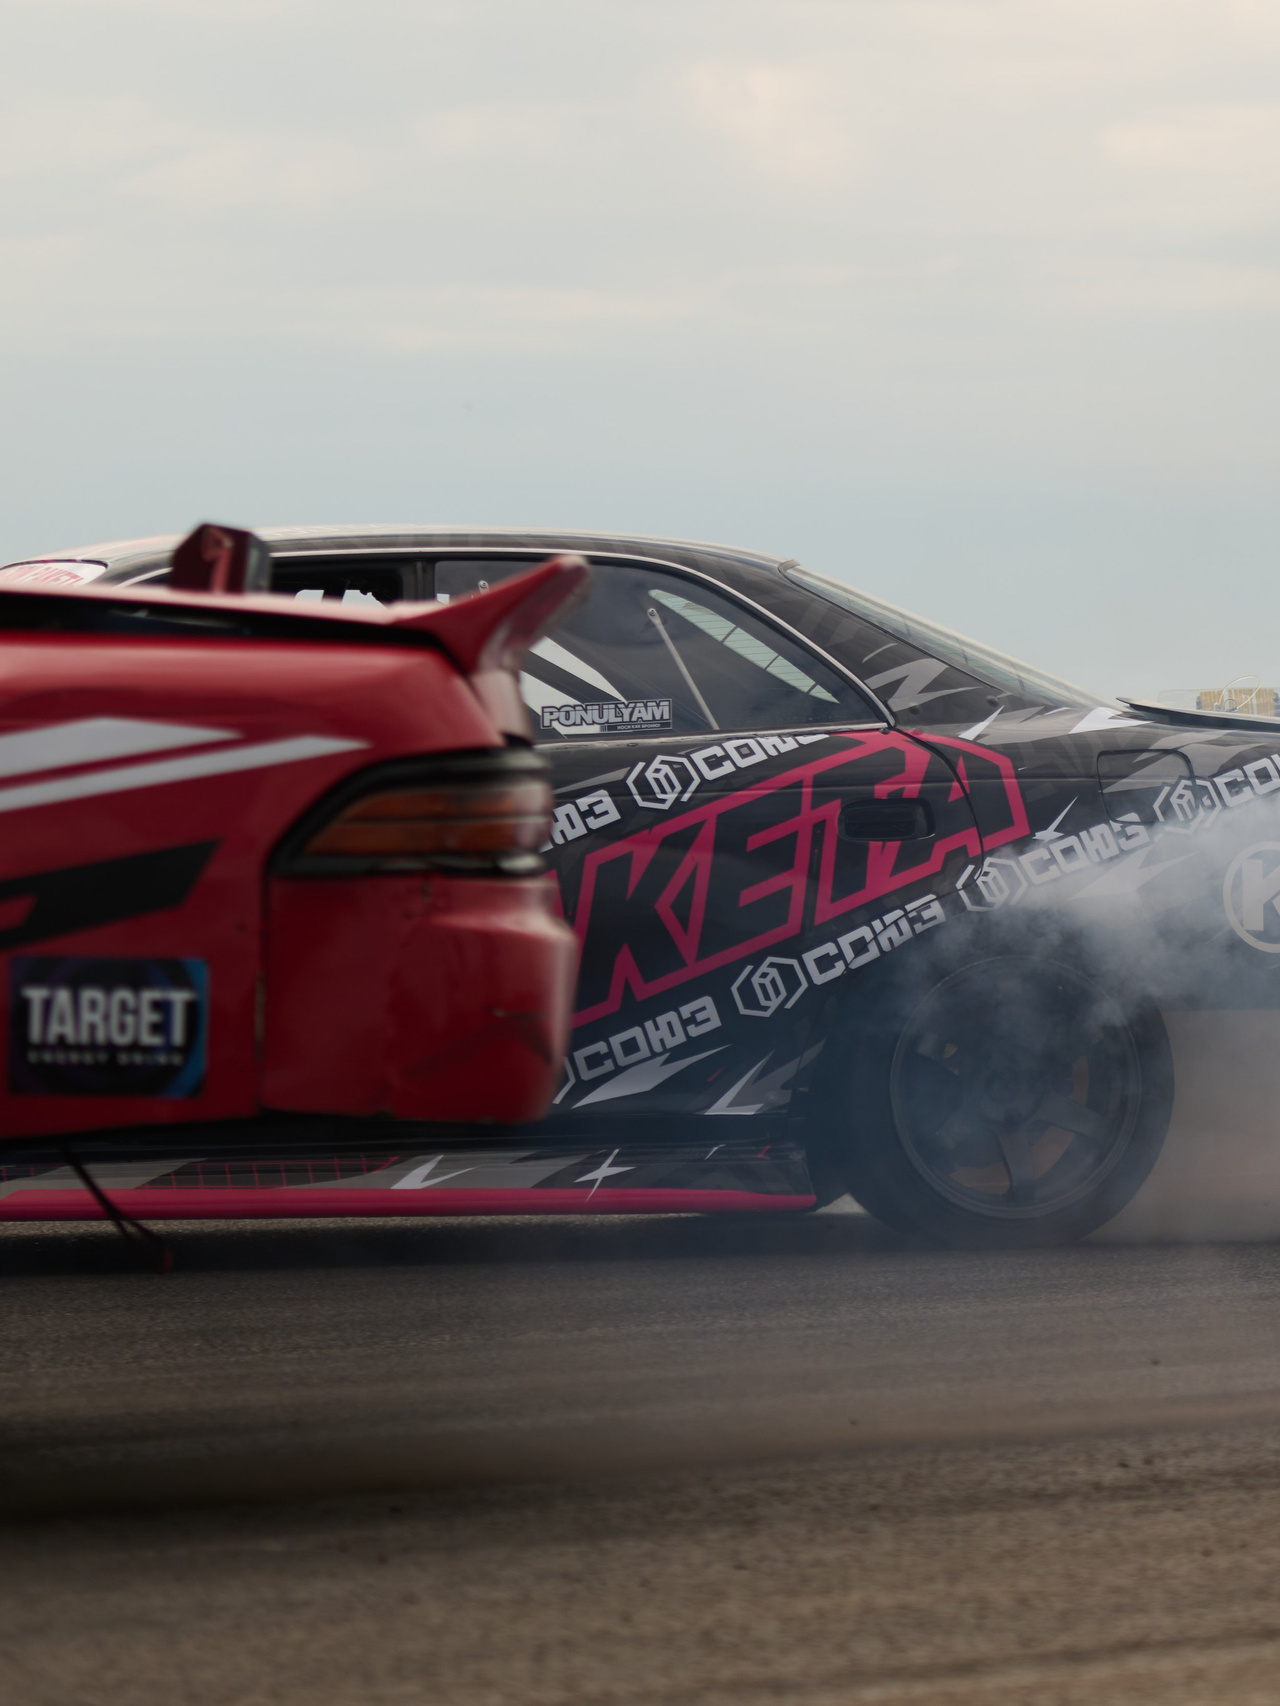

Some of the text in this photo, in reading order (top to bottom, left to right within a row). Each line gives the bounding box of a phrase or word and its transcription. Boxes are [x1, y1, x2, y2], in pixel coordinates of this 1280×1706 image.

[541, 700, 671, 728] PONULYAM
[540, 734, 830, 852] ЮЗ СОЮ
[552, 729, 1031, 1030] КЕТА
[573, 996, 722, 1081] СОЮЗ
[802, 894, 946, 985] СОЮЗ
[1018, 812, 1150, 885] СОЮЗ
[22, 986, 196, 1047] TARGET
